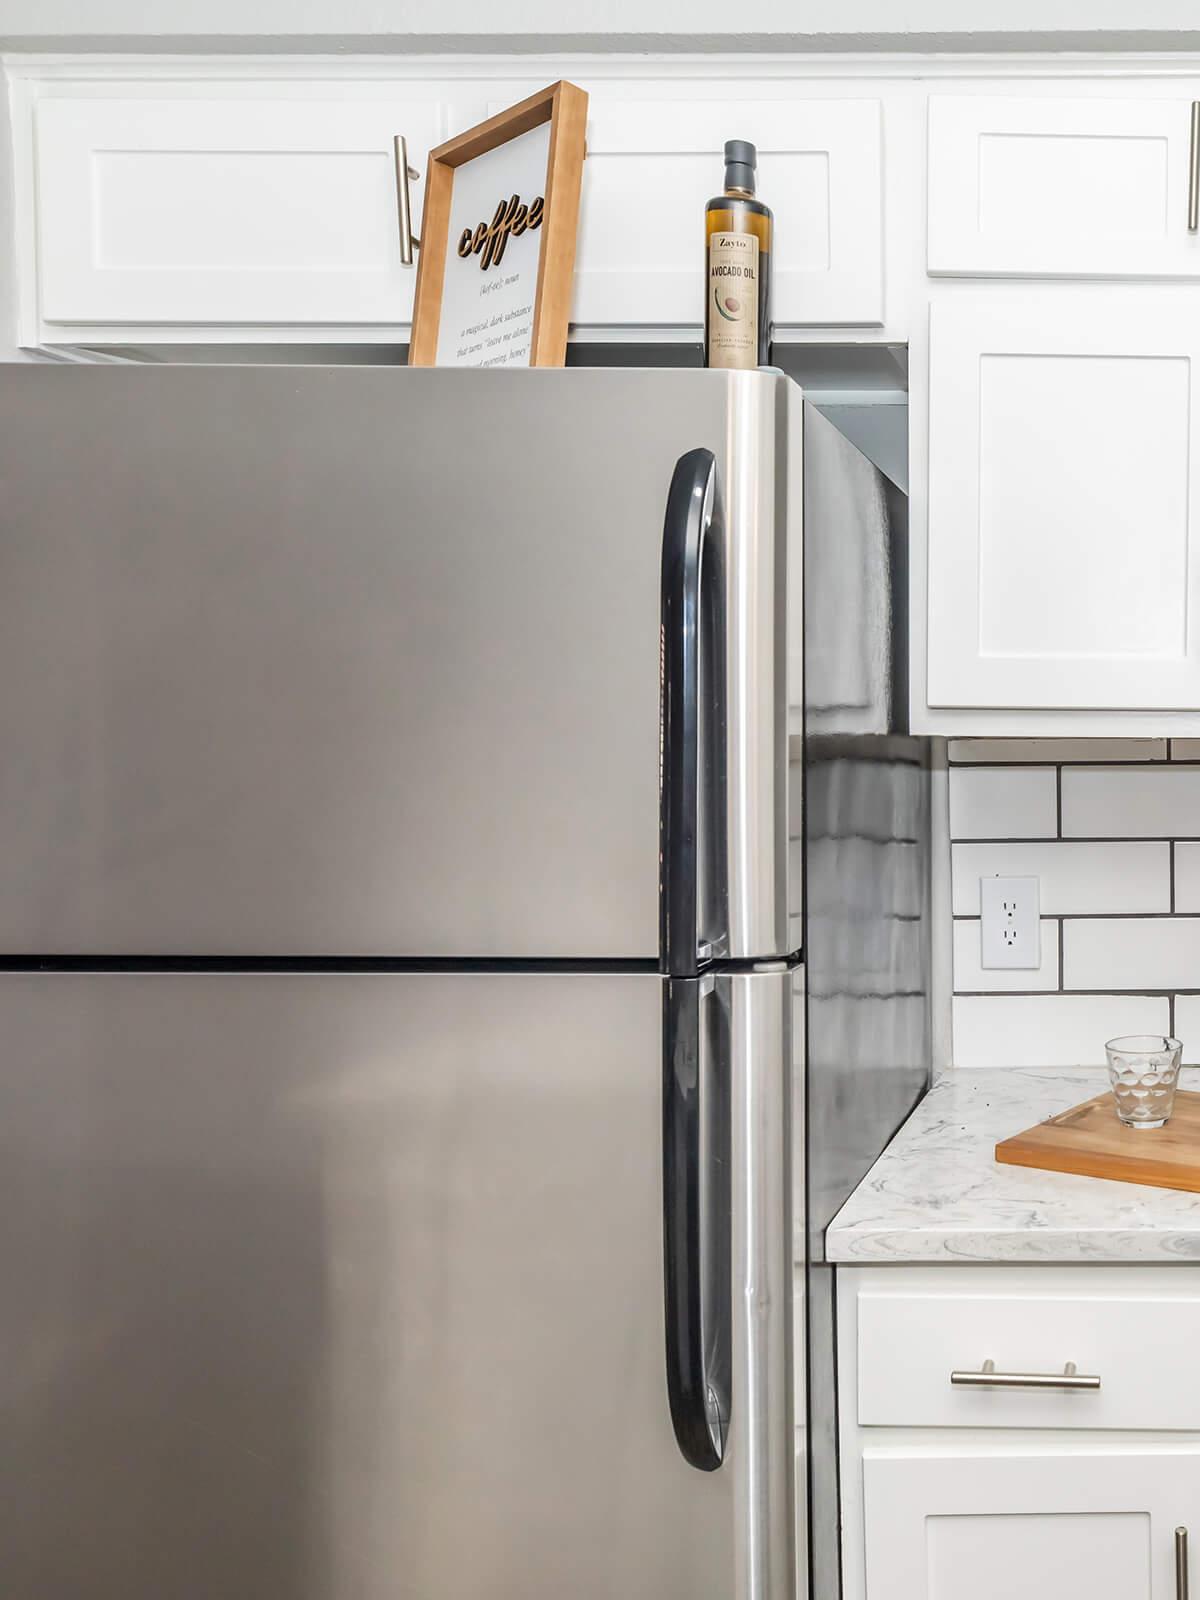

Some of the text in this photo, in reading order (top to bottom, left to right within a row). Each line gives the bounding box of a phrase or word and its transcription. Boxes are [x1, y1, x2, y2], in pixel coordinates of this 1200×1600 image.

[458, 194, 544, 271] coffee
[719, 238, 746, 248] Zayto
[711, 266, 757, 280] AVOCADO OIL
